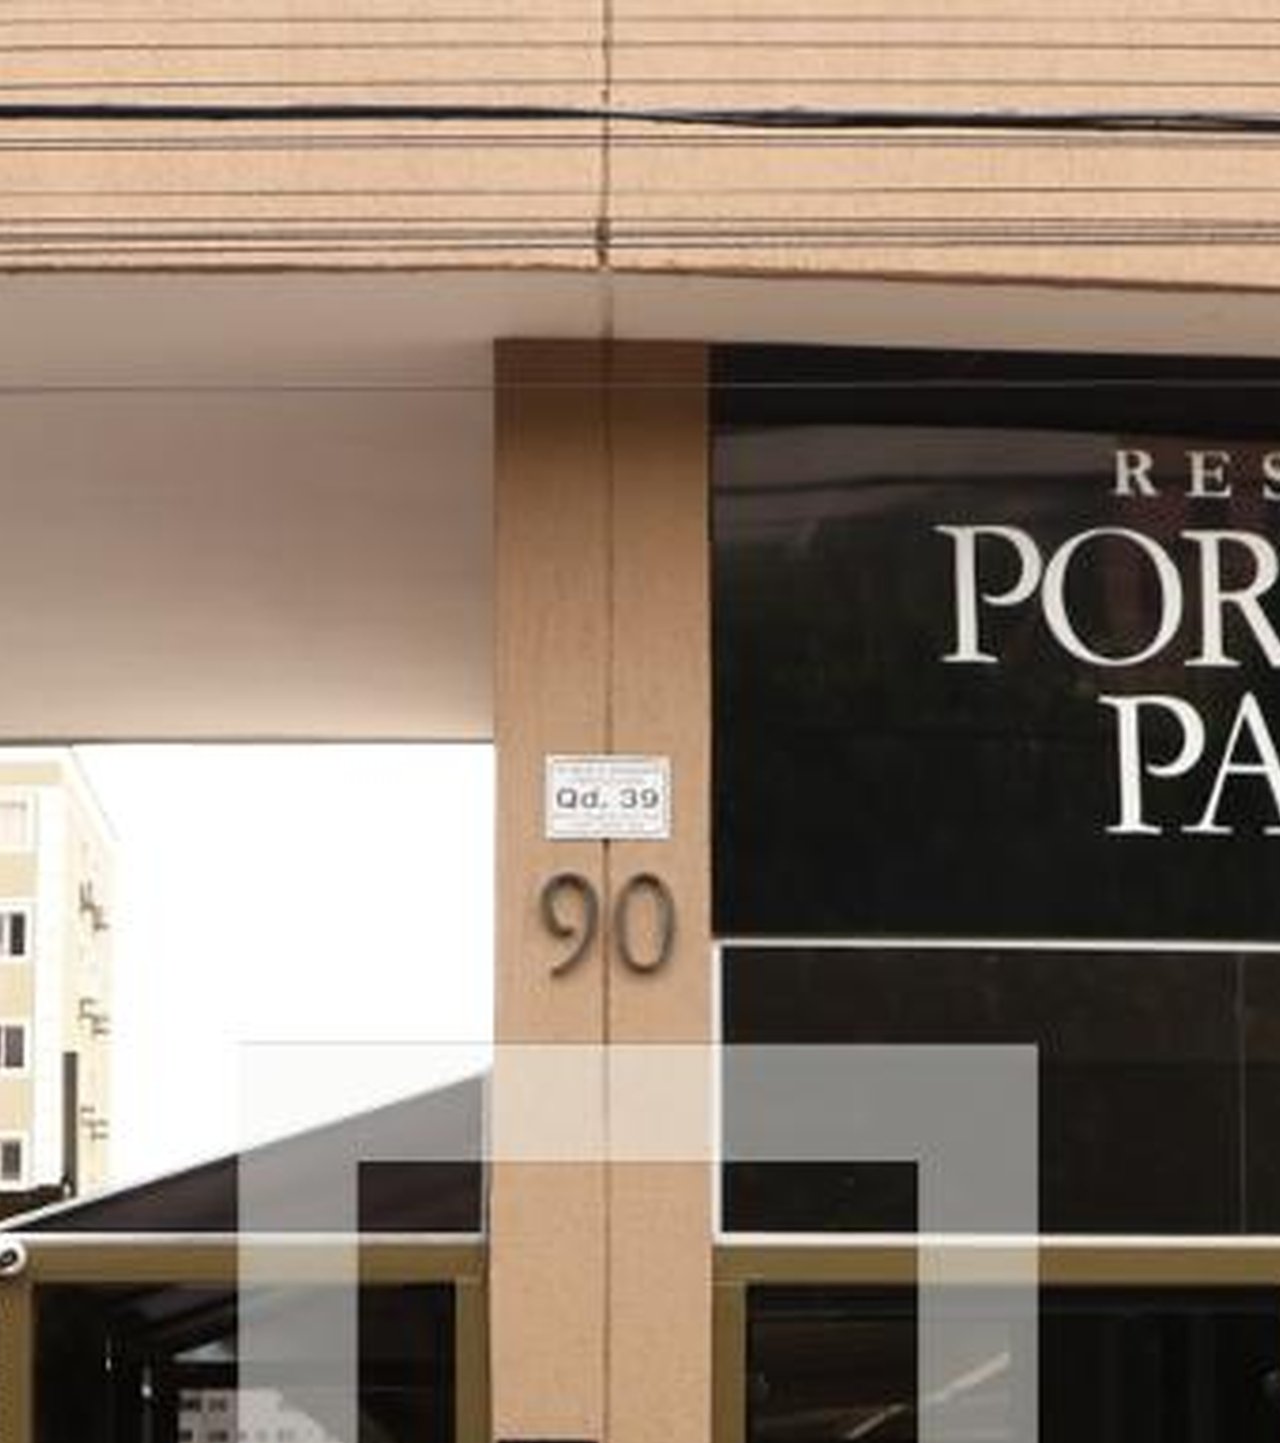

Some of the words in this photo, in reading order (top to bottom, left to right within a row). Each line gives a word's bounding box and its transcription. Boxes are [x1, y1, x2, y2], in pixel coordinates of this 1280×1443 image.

[555, 786, 609, 810] Qd.
[619, 786, 660, 810] 39
[540, 870, 677, 980] 90
